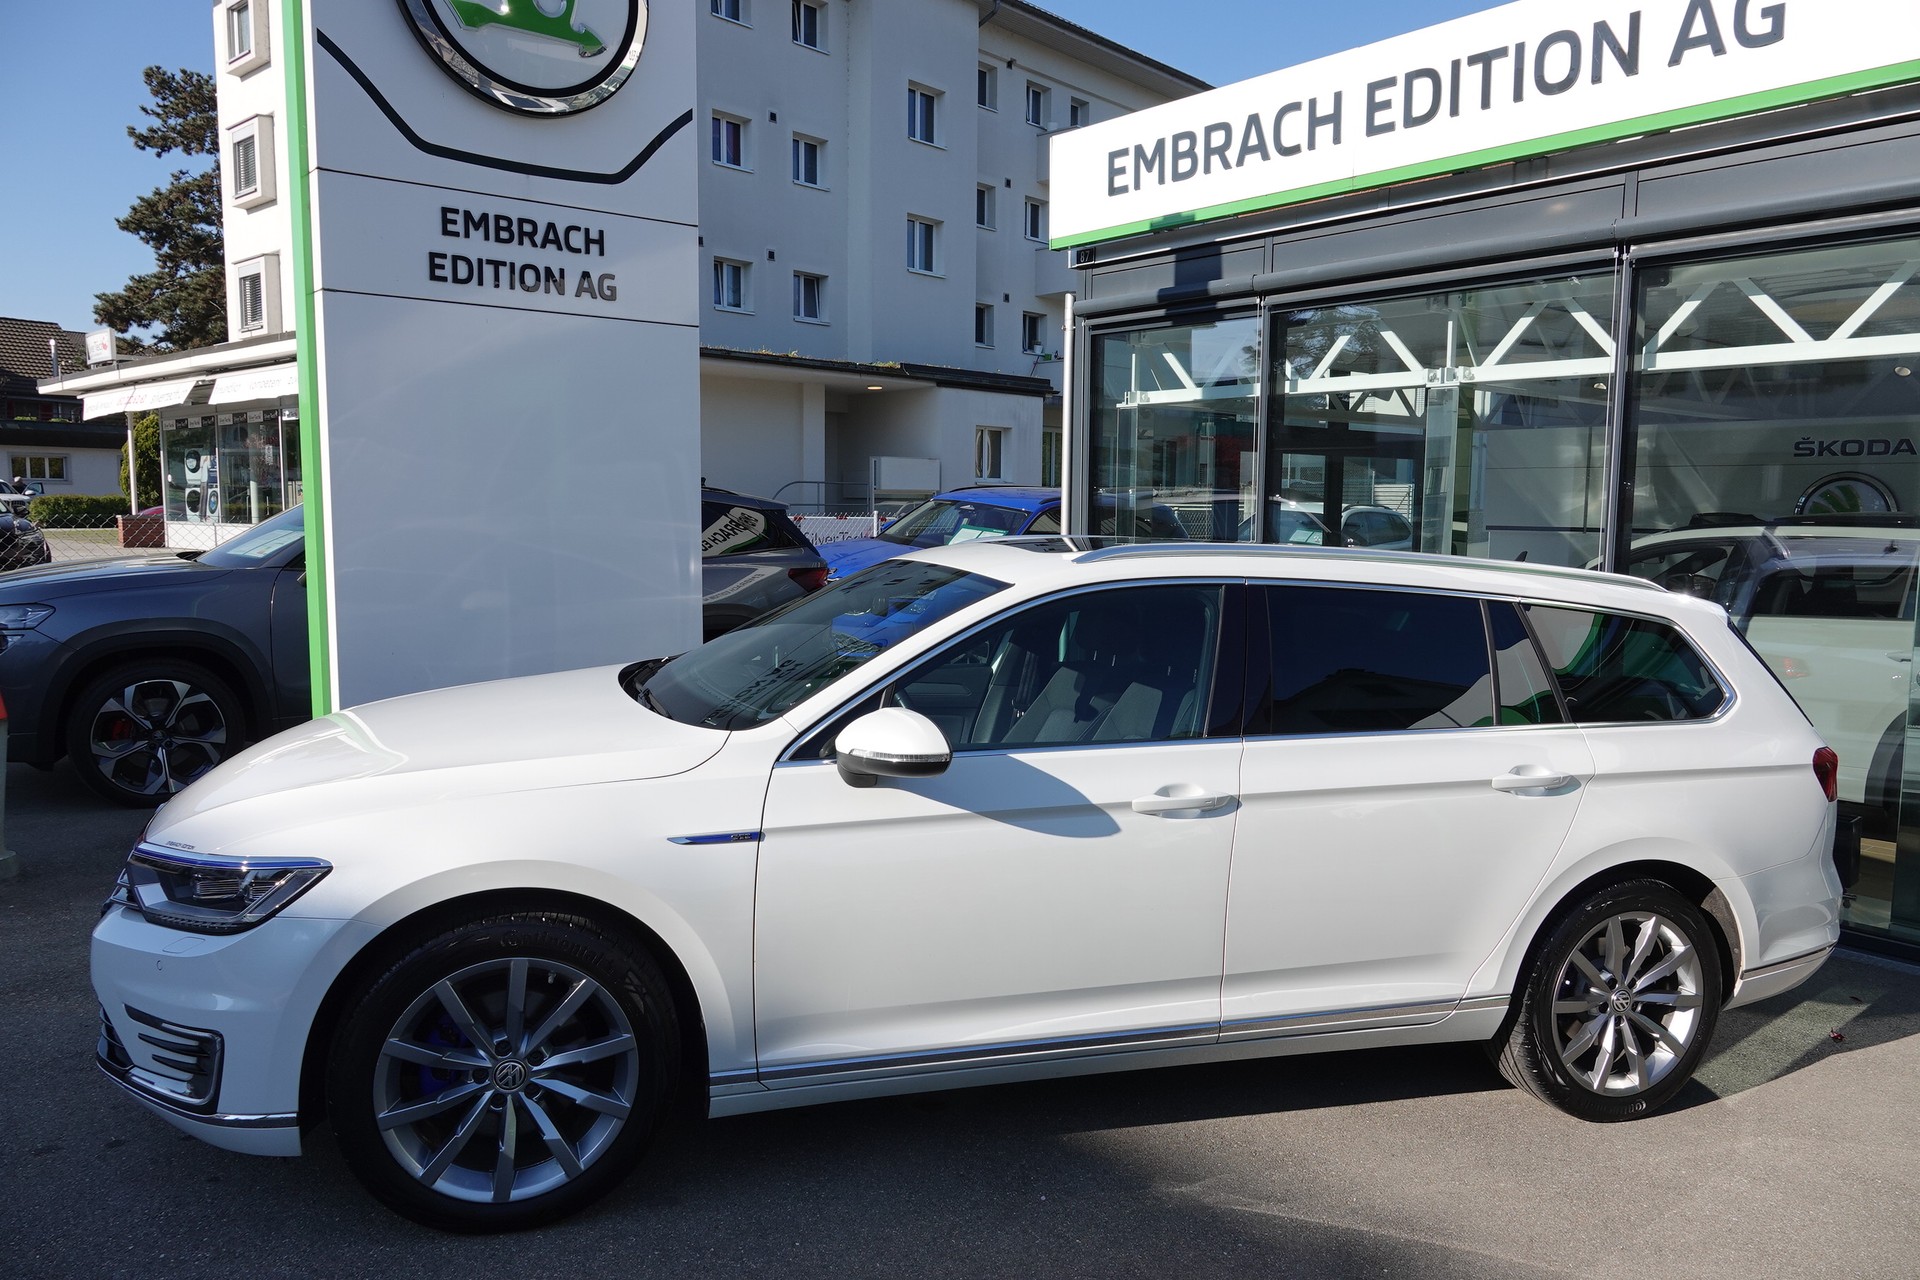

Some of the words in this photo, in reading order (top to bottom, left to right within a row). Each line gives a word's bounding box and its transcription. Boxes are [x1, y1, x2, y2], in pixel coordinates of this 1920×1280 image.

[1107, 91, 1343, 197] EMBRACH
[1366, 9, 1641, 137] EDITION
[1668, 0, 1786, 67] AG
[440, 206, 605, 257] EMBRACH
[1080, 250, 1090, 263] 87
[428, 251, 566, 296] EDITION
[574, 271, 618, 302] AG
[1793, 436, 1918, 457] ŠKODA
